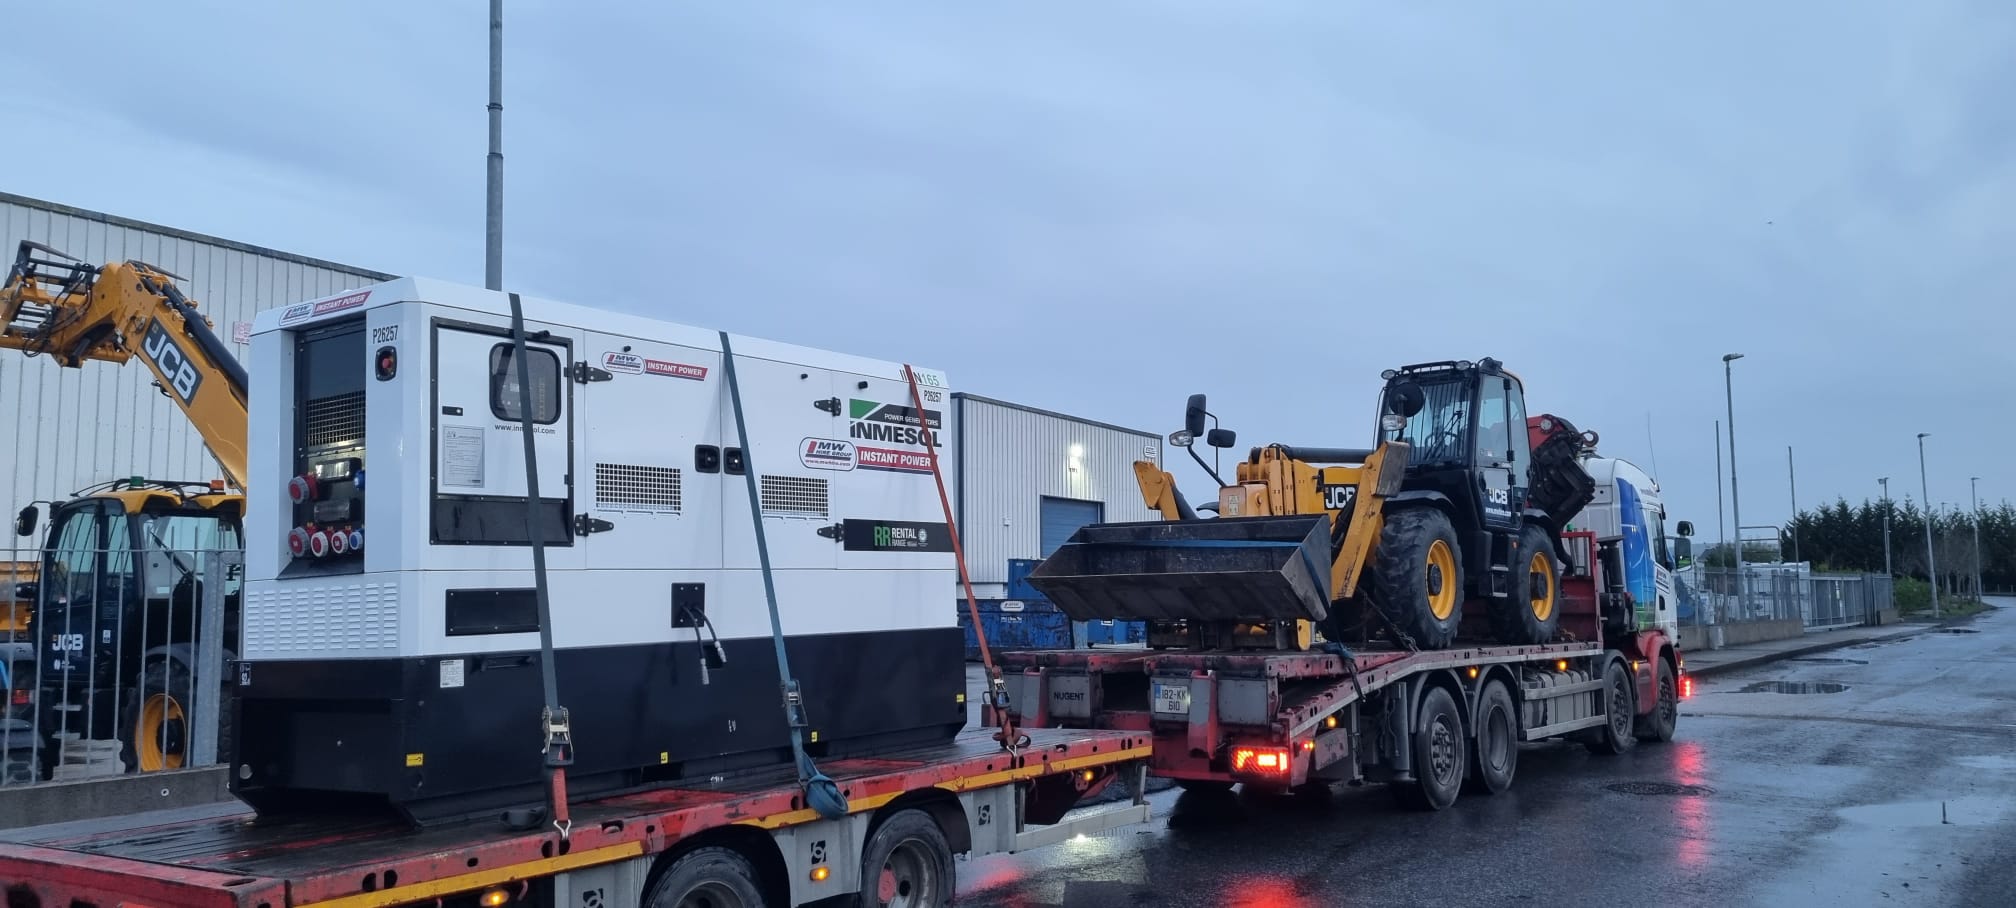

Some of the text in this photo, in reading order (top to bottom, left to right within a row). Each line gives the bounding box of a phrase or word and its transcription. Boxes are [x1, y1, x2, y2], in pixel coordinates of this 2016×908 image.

[316, 294, 366, 312] INSTANT POWER
[373, 326, 398, 343] P26257
[145, 334, 197, 399] JCB
[647, 362, 677, 372] INSTANT
[678, 367, 702, 376] POWER
[884, 413, 938, 425] POWER GENETORS
[494, 424, 555, 434] www.inol.com
[850, 421, 942, 447] INMESOL
[818, 442, 845, 451] MW
[860, 451, 931, 467] INSTANT POWER
[1489, 488, 1507, 504] JCB
[874, 526, 891, 546] RR
[891, 528, 917, 538] RENTAL
[52, 634, 84, 651] JCB
[1053, 691, 1084, 701] NUGENT
